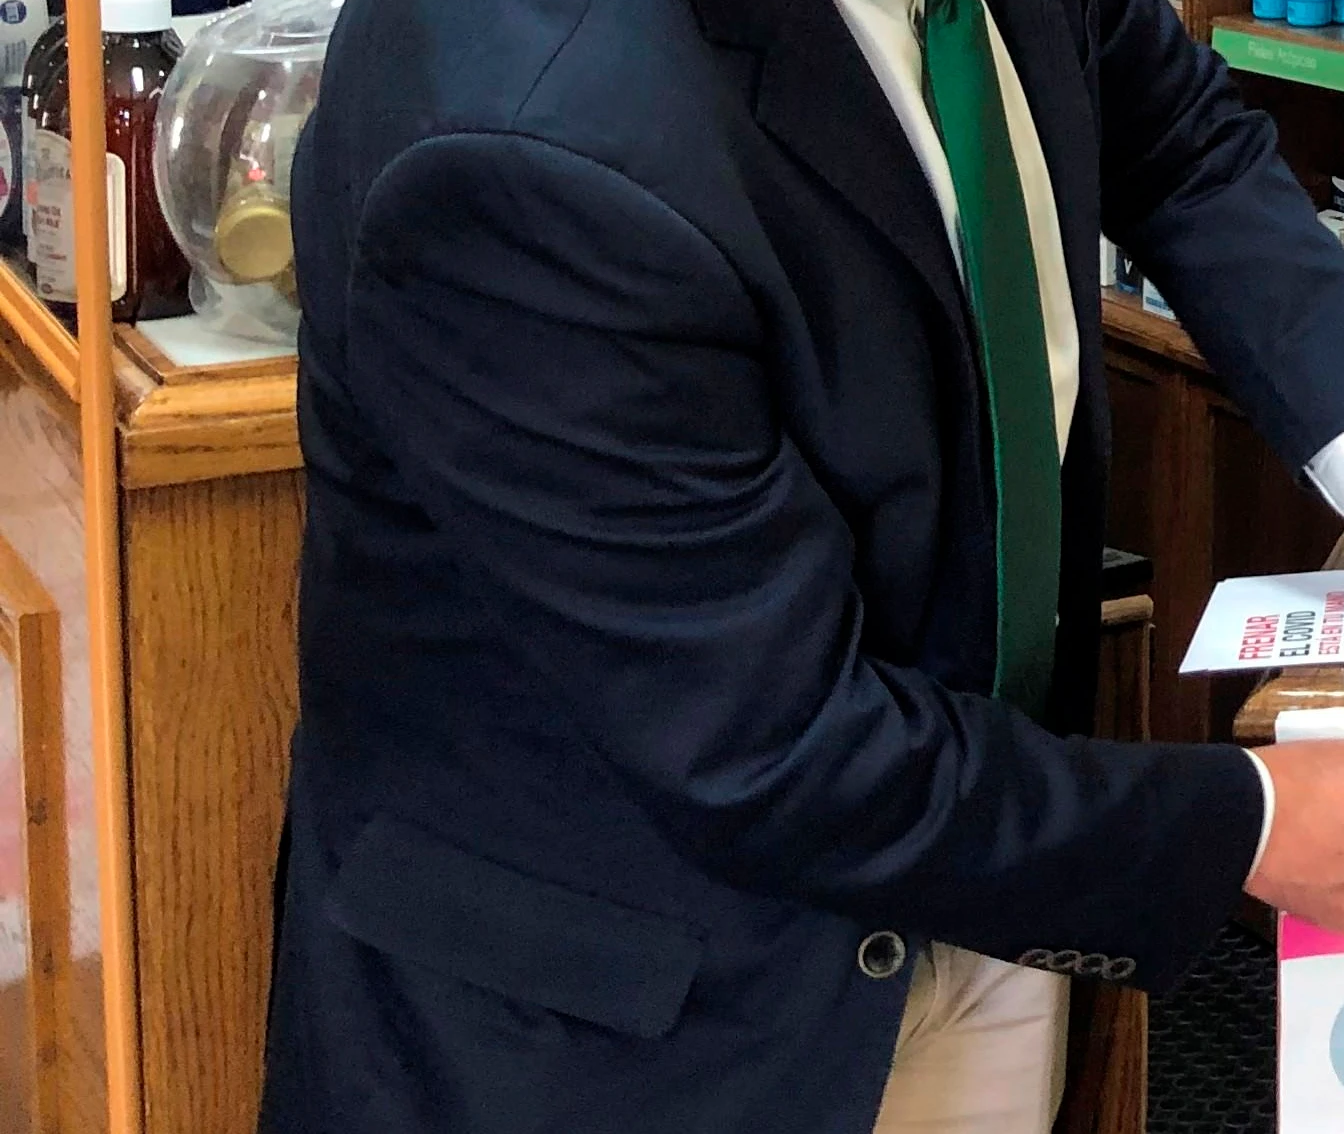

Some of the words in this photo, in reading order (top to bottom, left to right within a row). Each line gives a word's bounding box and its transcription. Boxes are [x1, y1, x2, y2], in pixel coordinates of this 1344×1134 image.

[1238, 614, 1280, 660] FRENAR
[1282, 611, 1316, 642] COVID
[1279, 643, 1311, 657] EL
